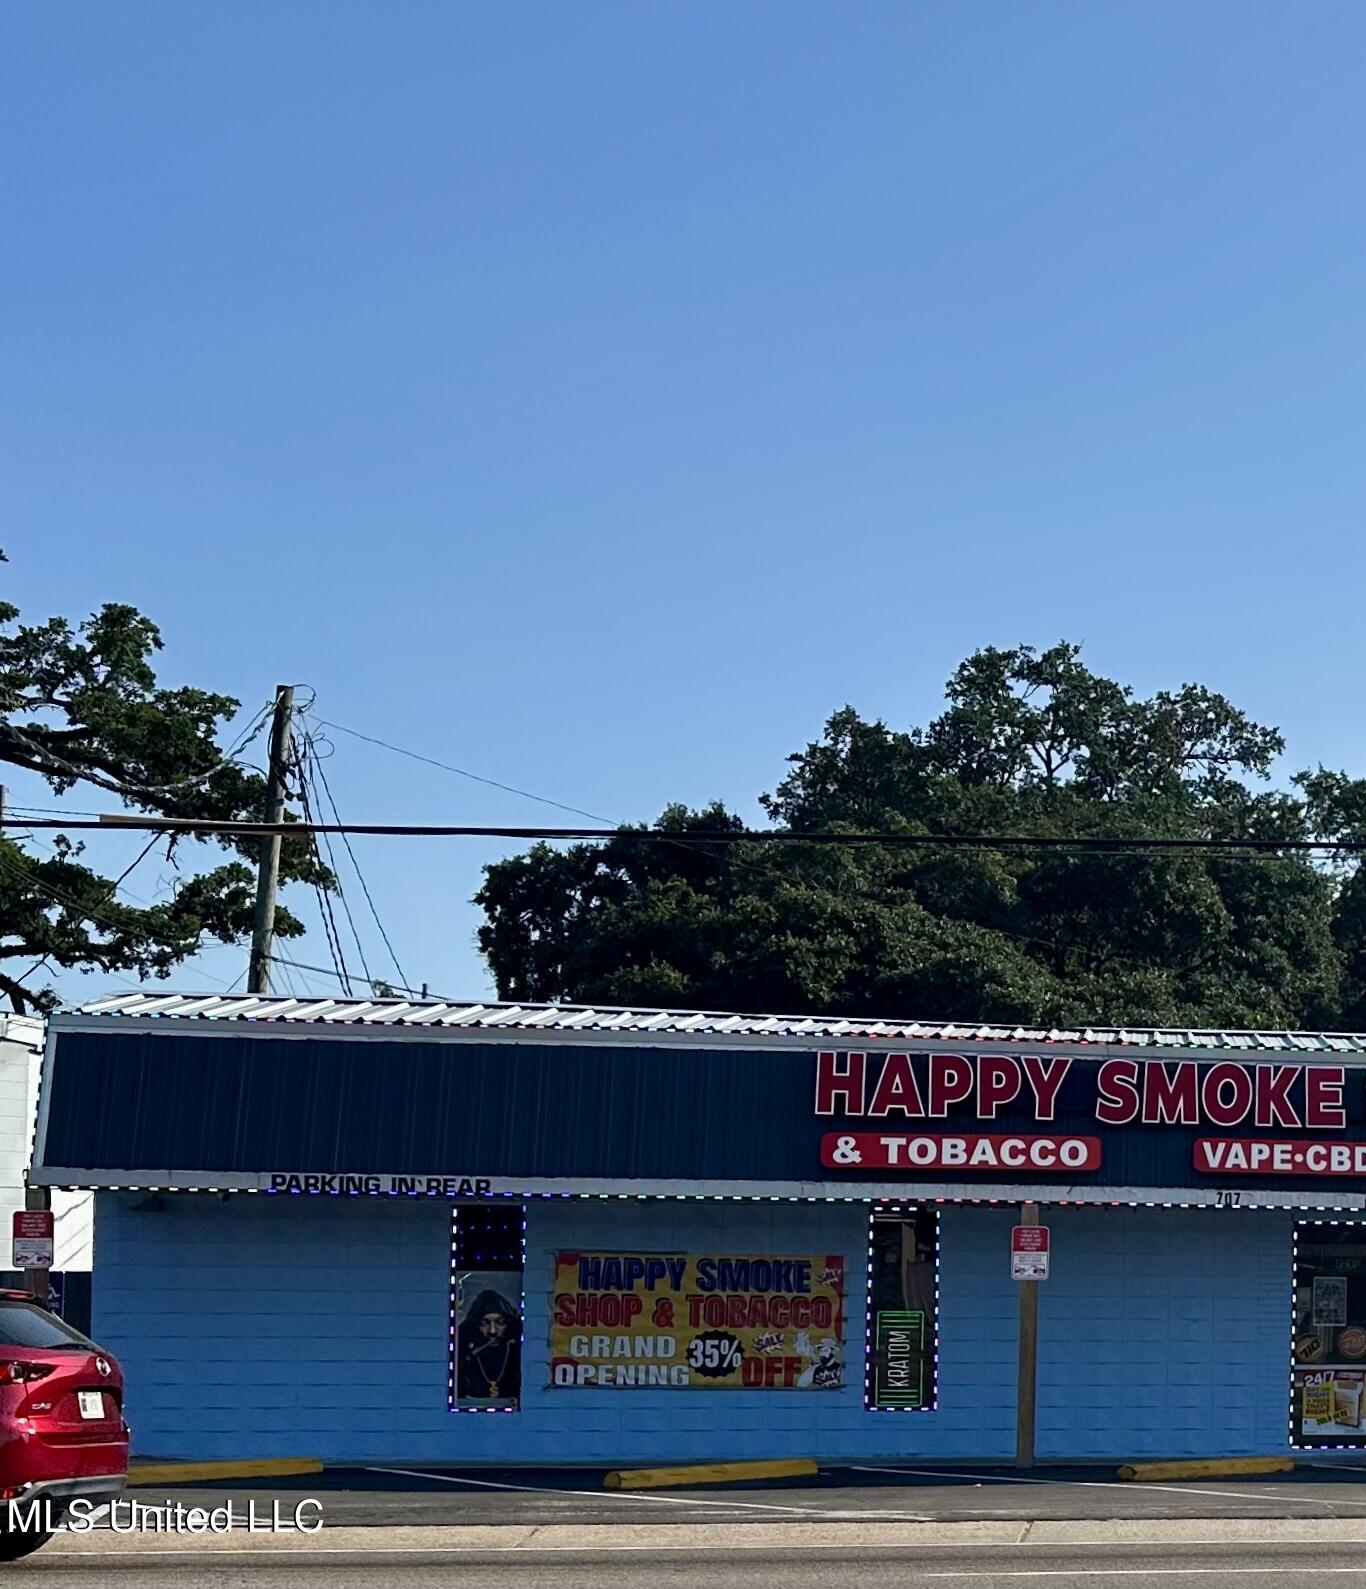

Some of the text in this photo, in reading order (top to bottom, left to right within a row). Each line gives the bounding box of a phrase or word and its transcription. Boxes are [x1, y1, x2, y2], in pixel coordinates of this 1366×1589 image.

[815, 1050, 1072, 1121] HAPPY
[1096, 1058, 1346, 1129] SMOKE
[832, 1136, 1088, 1167] & TOBACCO
[271, 1173, 491, 1195] PARKING IN REAR
[578, 1256, 811, 1294] HAPPY SMOKE
[555, 1293, 833, 1329] SHOP & TOBACCO
[570, 1335, 676, 1359] GRAND
[689, 1339, 743, 1369] 35%
[888, 1331, 911, 1387] KRATOM
[554, 1363, 690, 1387] OPENING
[741, 1355, 802, 1388] OFF
